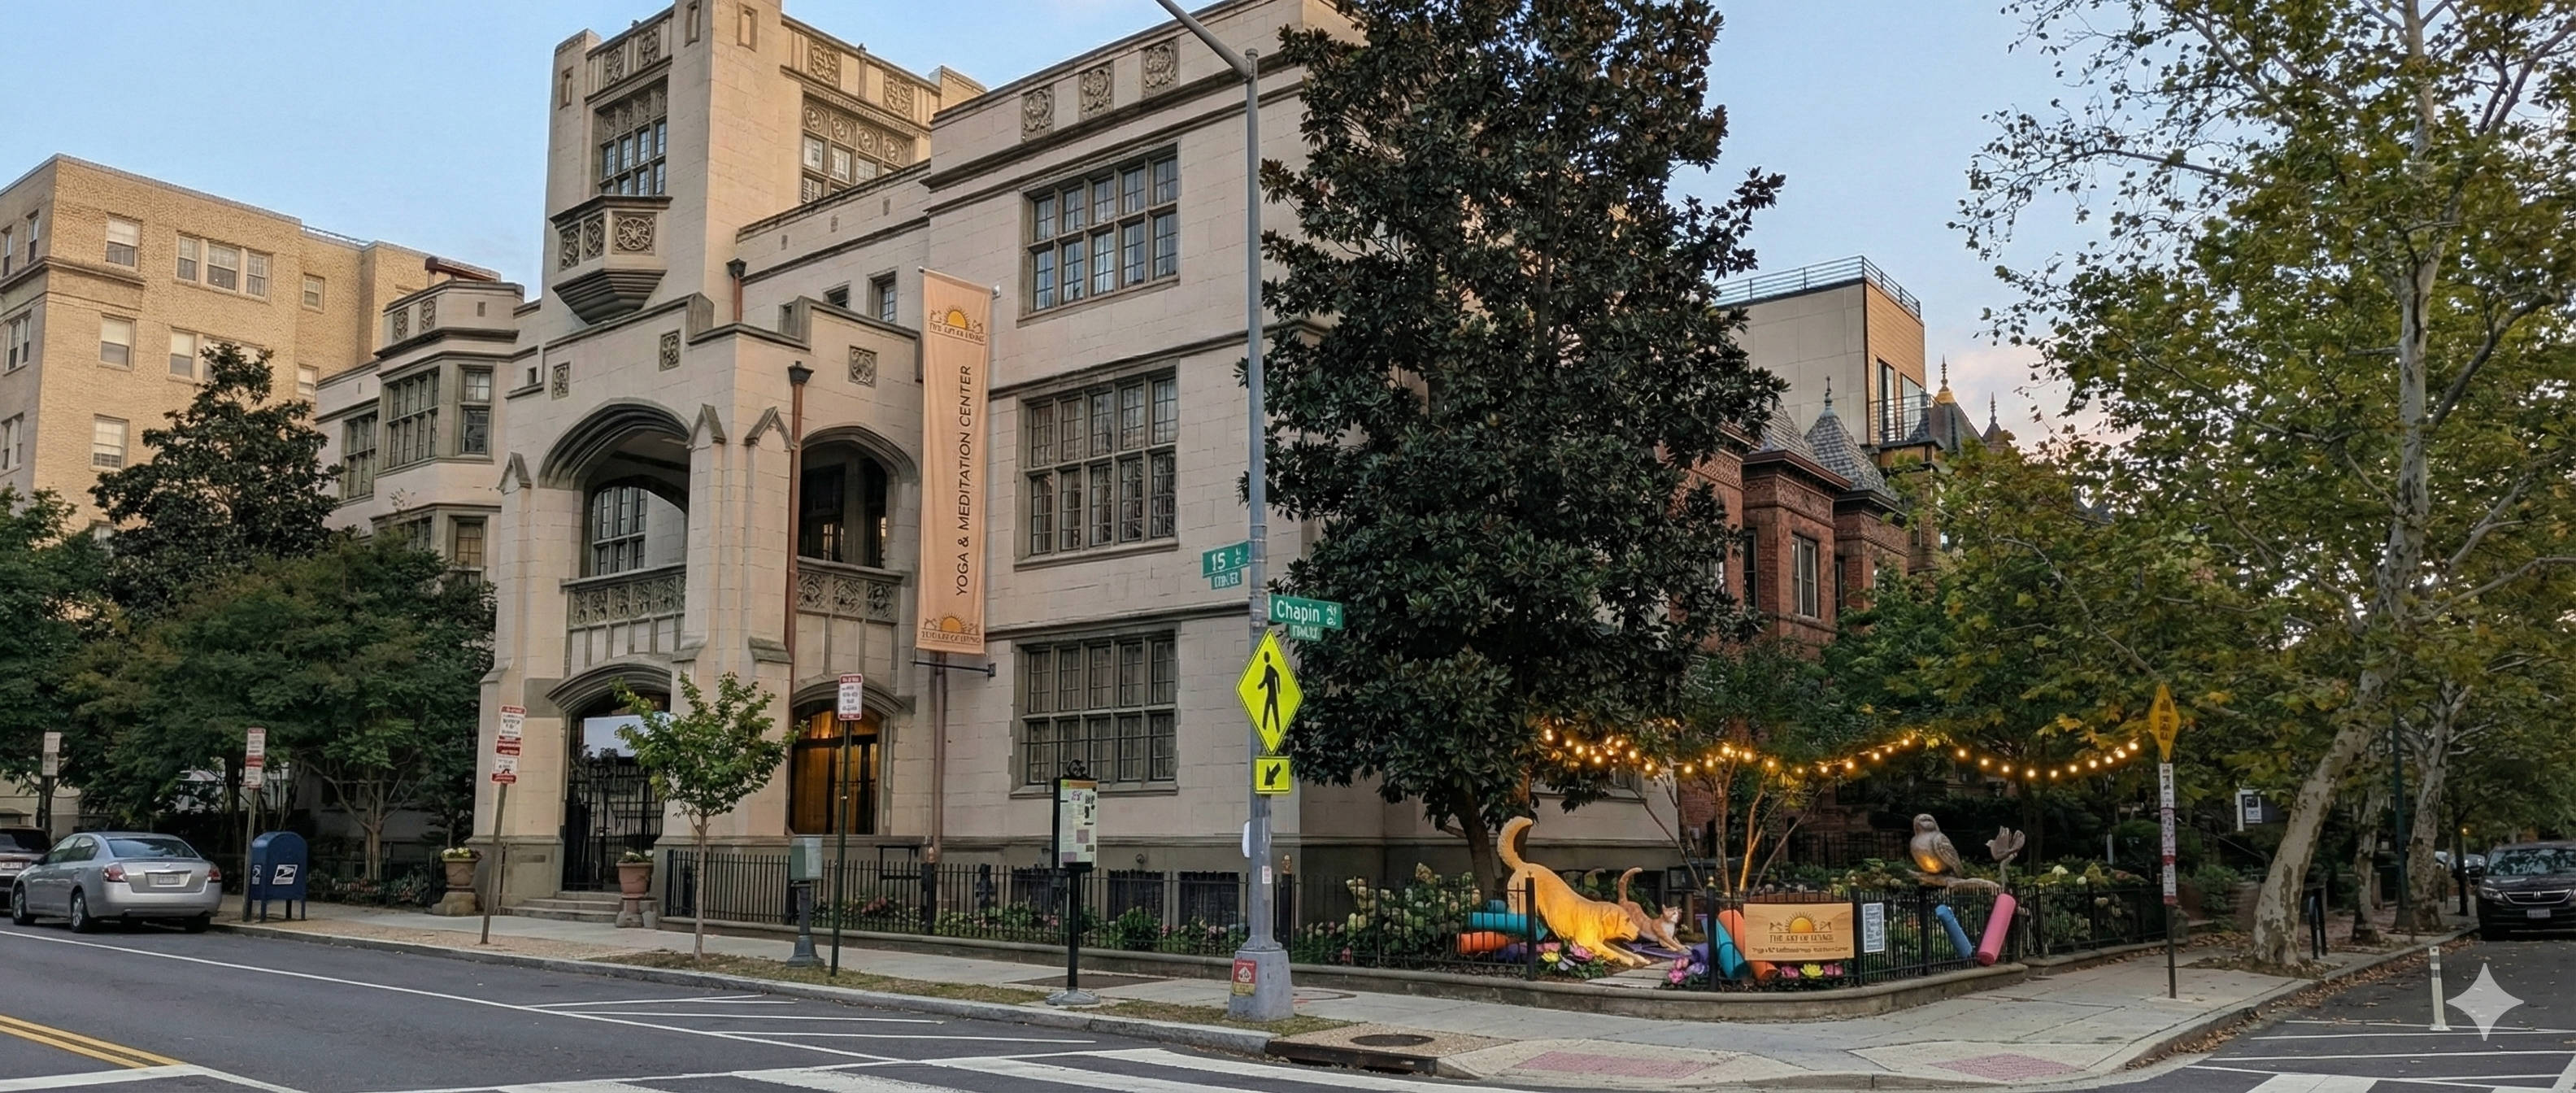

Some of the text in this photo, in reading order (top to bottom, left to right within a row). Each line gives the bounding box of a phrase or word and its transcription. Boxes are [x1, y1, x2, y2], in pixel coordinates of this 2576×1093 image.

[956, 365, 972, 596] YOGA & MEDITATION CENTER
[1212, 552, 1226, 571] 15
[1277, 599, 1321, 625] Chapin
